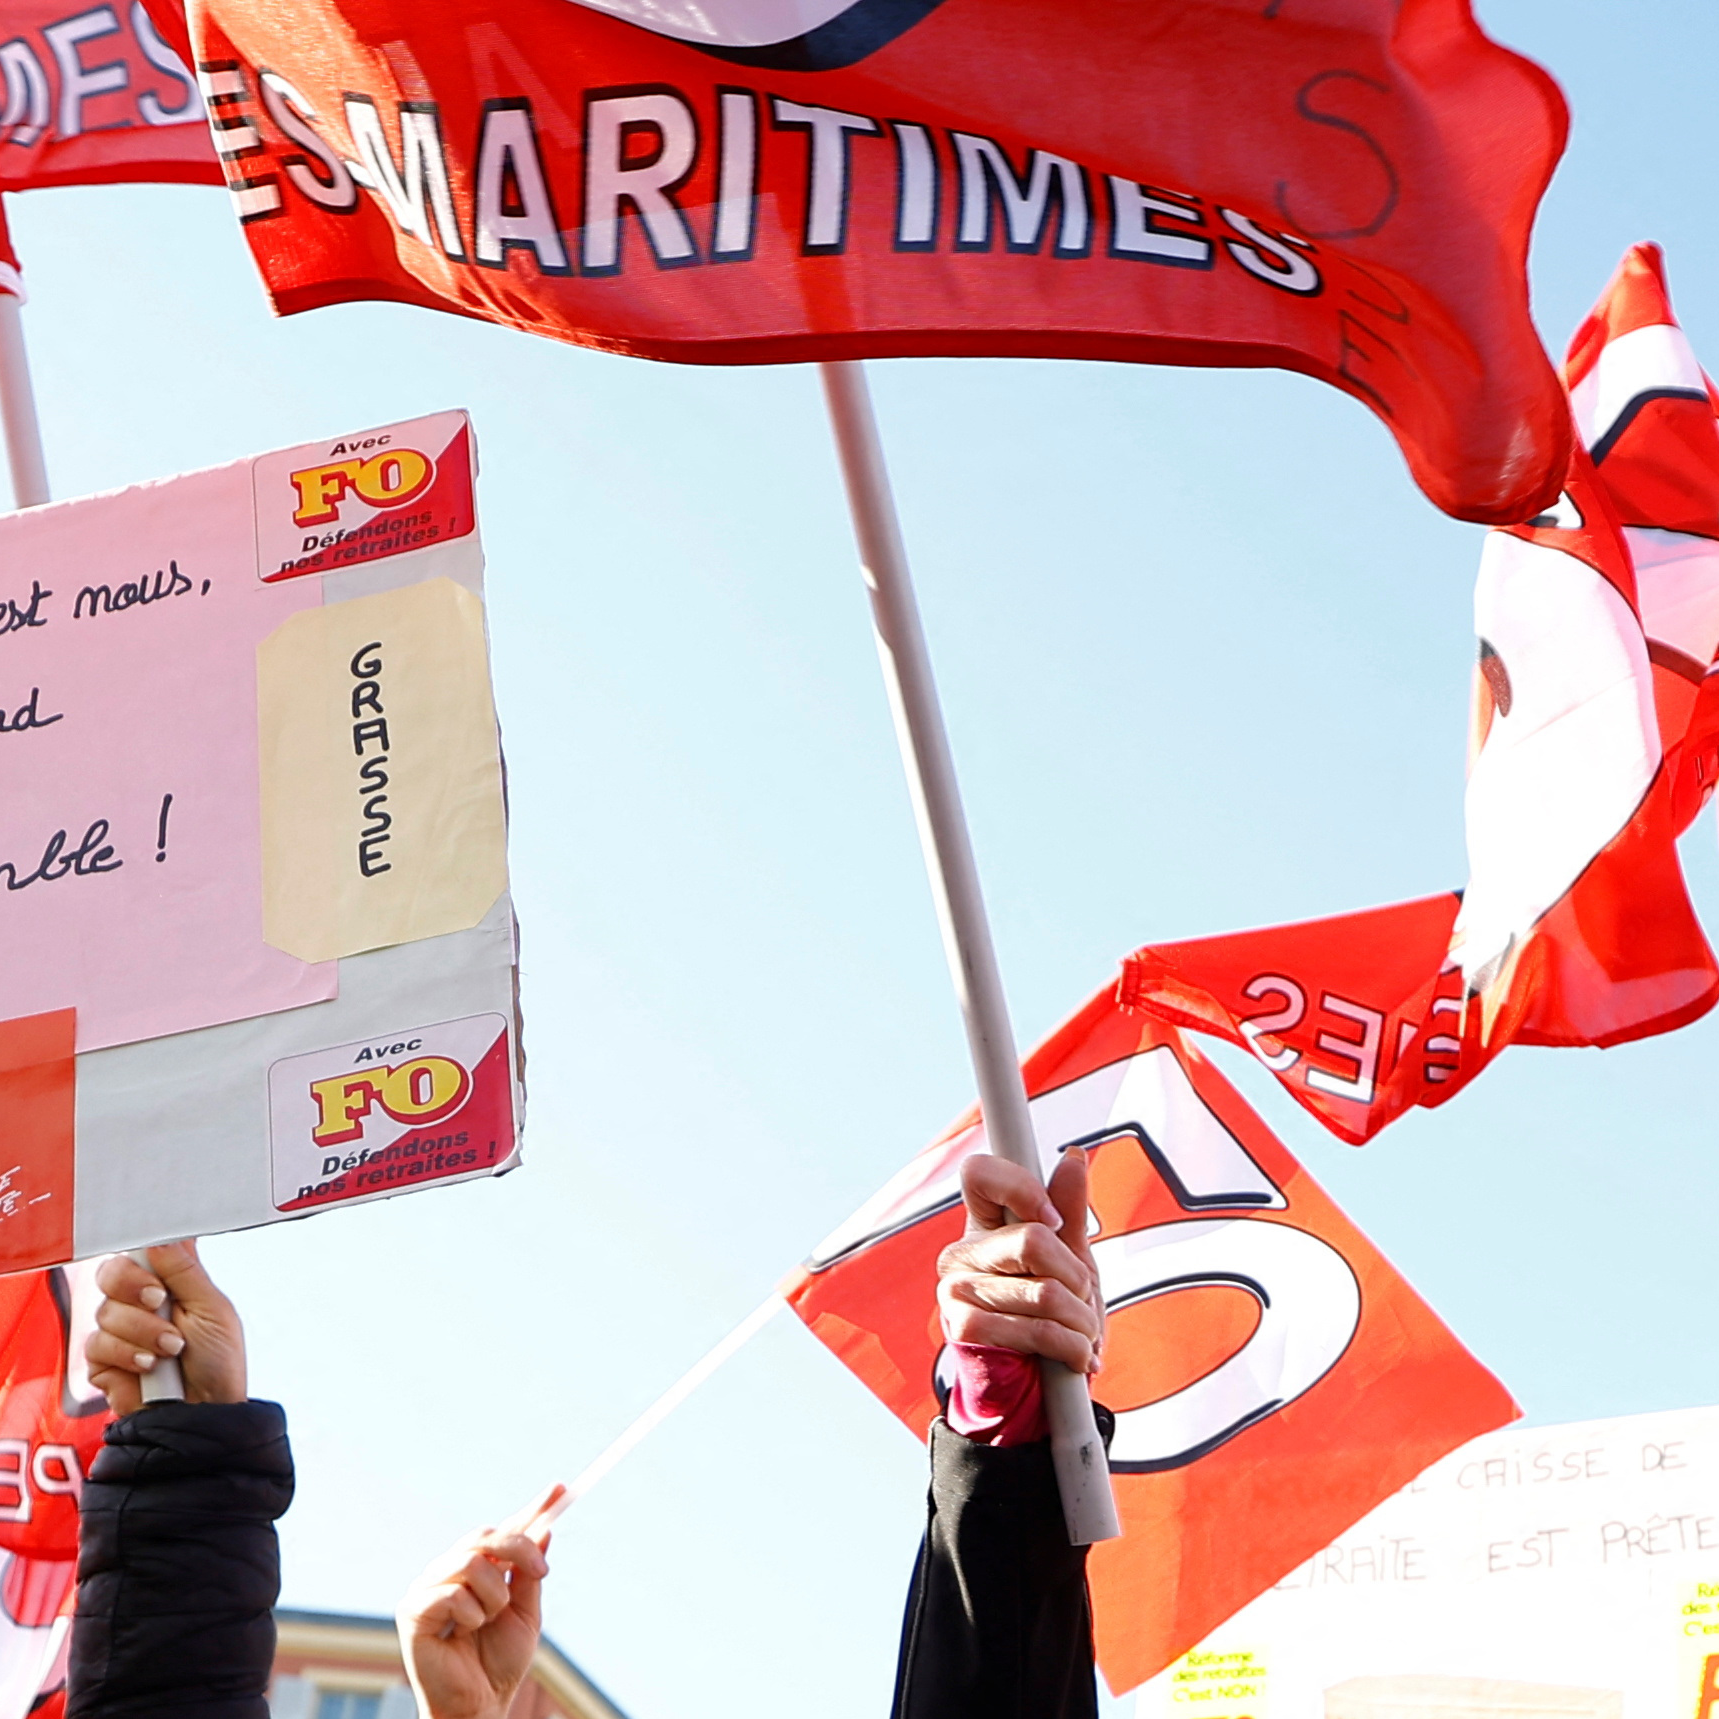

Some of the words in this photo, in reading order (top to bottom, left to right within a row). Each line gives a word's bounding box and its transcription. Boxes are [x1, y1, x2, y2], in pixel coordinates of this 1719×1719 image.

[330, 433, 391, 457] Avec
[290, 447, 433, 528] FO
[280, 553, 325, 574] nos
[333, 524, 439, 564] retraites
[302, 511, 432, 552] Défendons
[73, 560, 212, 619] nous,
[351, 641, 392, 878] GRASSE
[155, 793, 173, 863] !
[354, 1038, 422, 1063] Avec
[310, 1055, 470, 1148] FO
[297, 1176, 345, 1200] nos
[357, 1148, 476, 1187] retraites
[321, 1131, 468, 1176] Défendons
[1642, 1441, 1688, 1473] DE
[1487, 1527, 1570, 1575] EST
